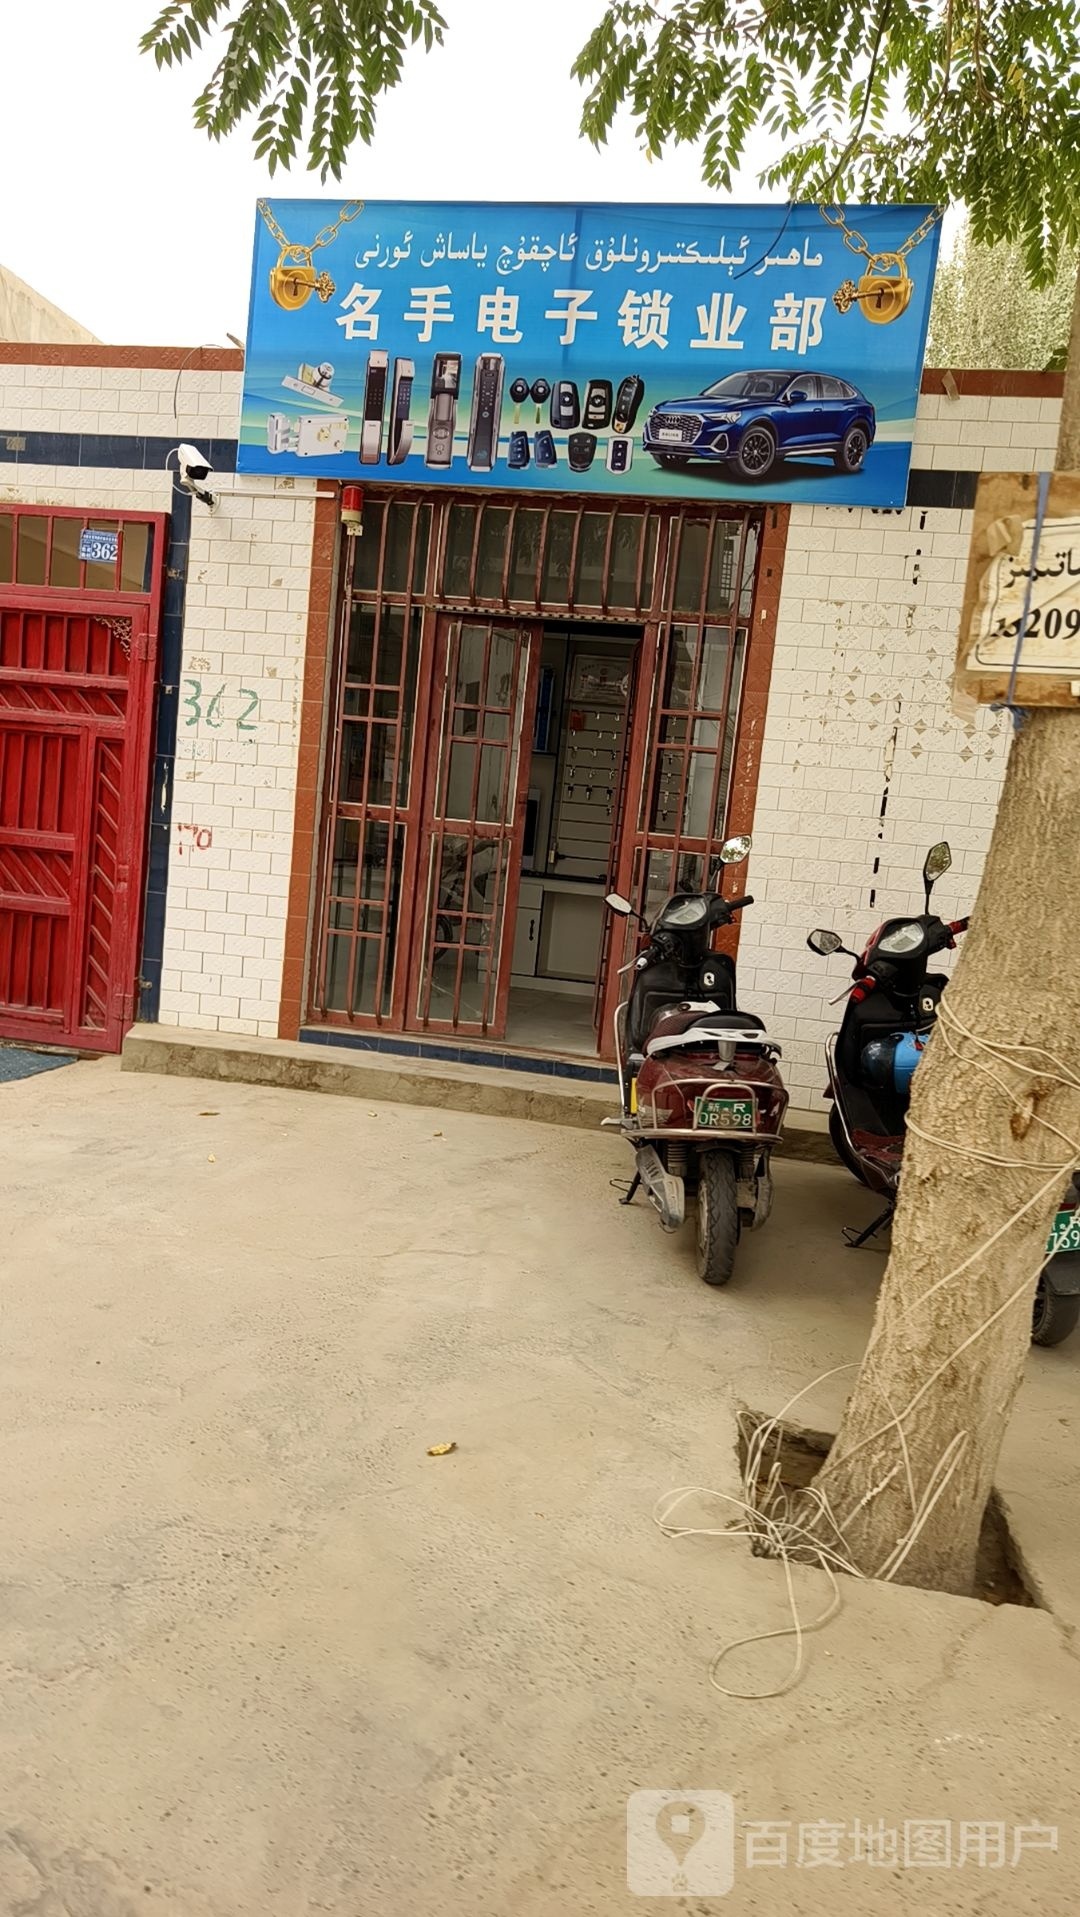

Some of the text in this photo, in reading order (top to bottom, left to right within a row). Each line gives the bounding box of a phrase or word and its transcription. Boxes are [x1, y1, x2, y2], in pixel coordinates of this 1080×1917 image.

[354, 229, 414, 269] ئورنى
[420, 231, 488, 269] ياساش
[335, 282, 827, 355] 名手电子锁业部
[91, 542, 119, 561] 362
[183, 678, 260, 729] 362
